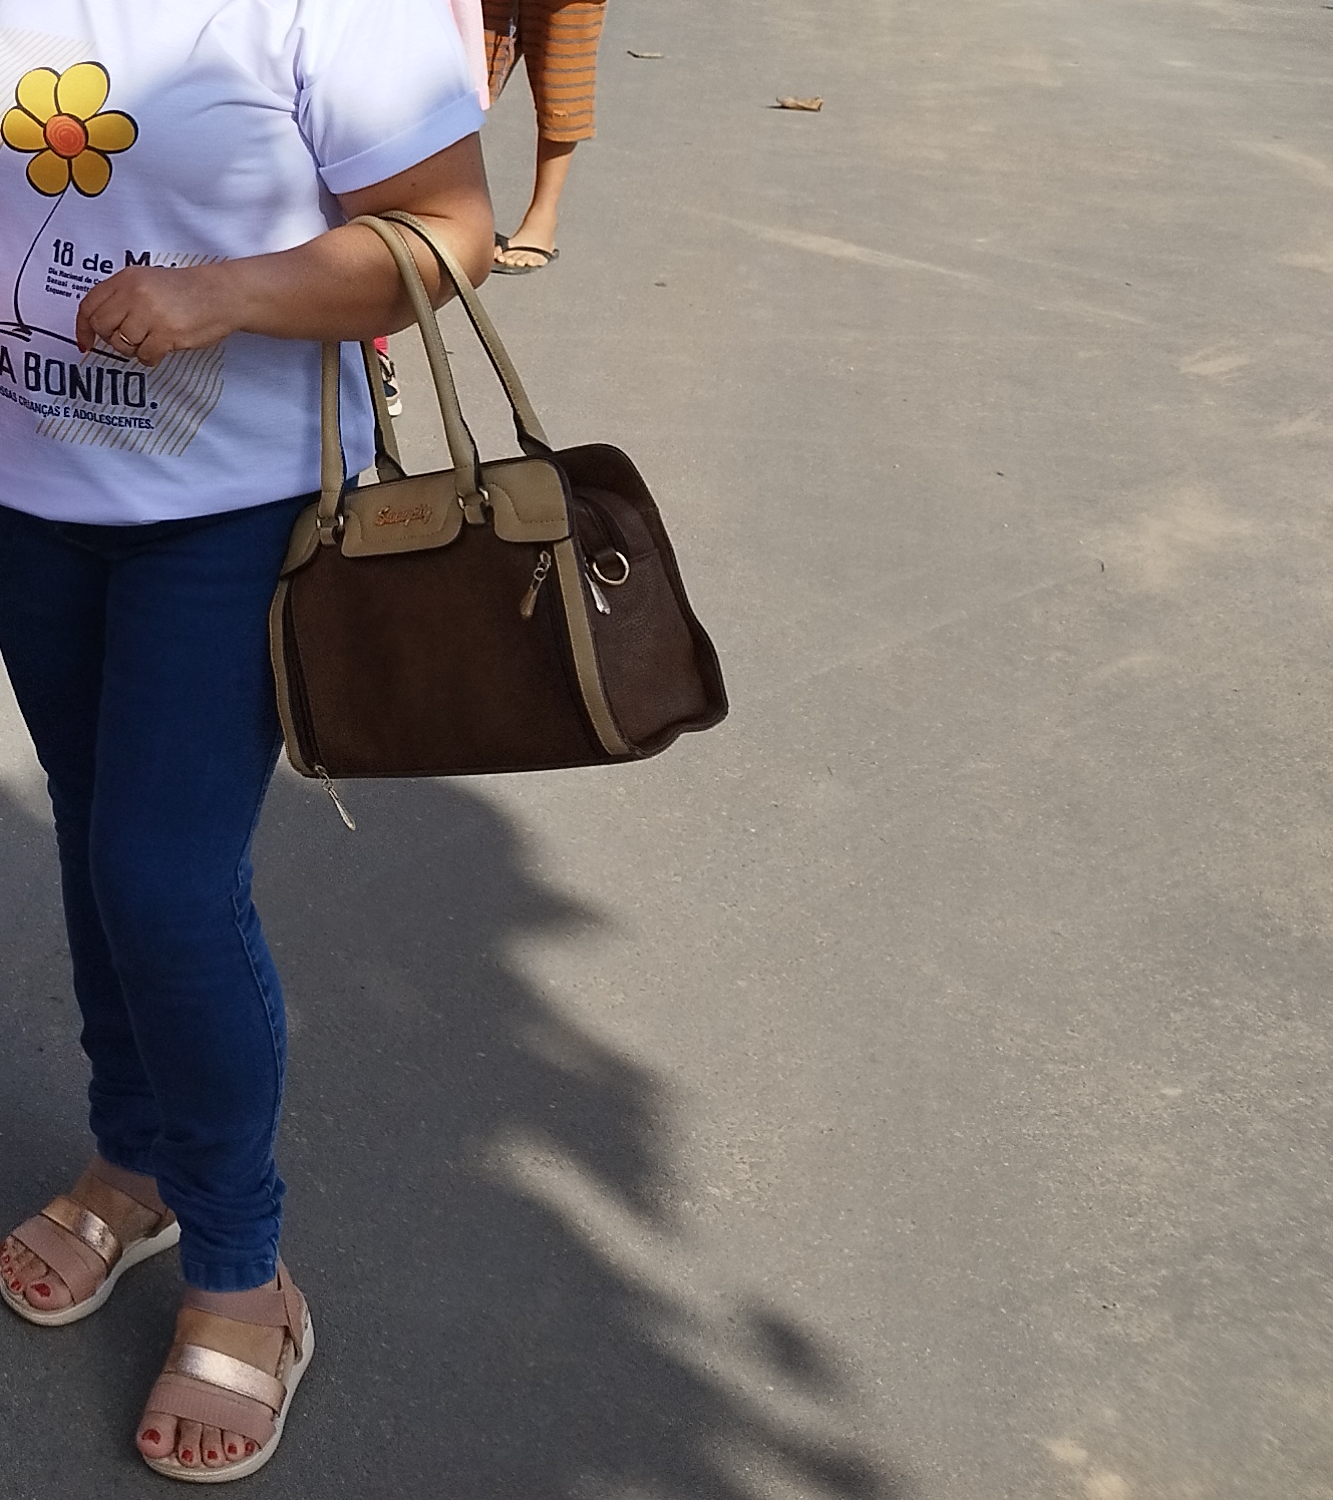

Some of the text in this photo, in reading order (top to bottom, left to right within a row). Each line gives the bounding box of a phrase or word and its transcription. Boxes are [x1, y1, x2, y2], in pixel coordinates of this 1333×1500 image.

[53, 238, 74, 267] 18
[82, 253, 113, 274] de
[24, 351, 158, 409] BONITO.
[18, 395, 61, 418] CRIANÇAS
[64, 406, 70, 417] E
[73, 409, 155, 430] ADOLESCENTES.
